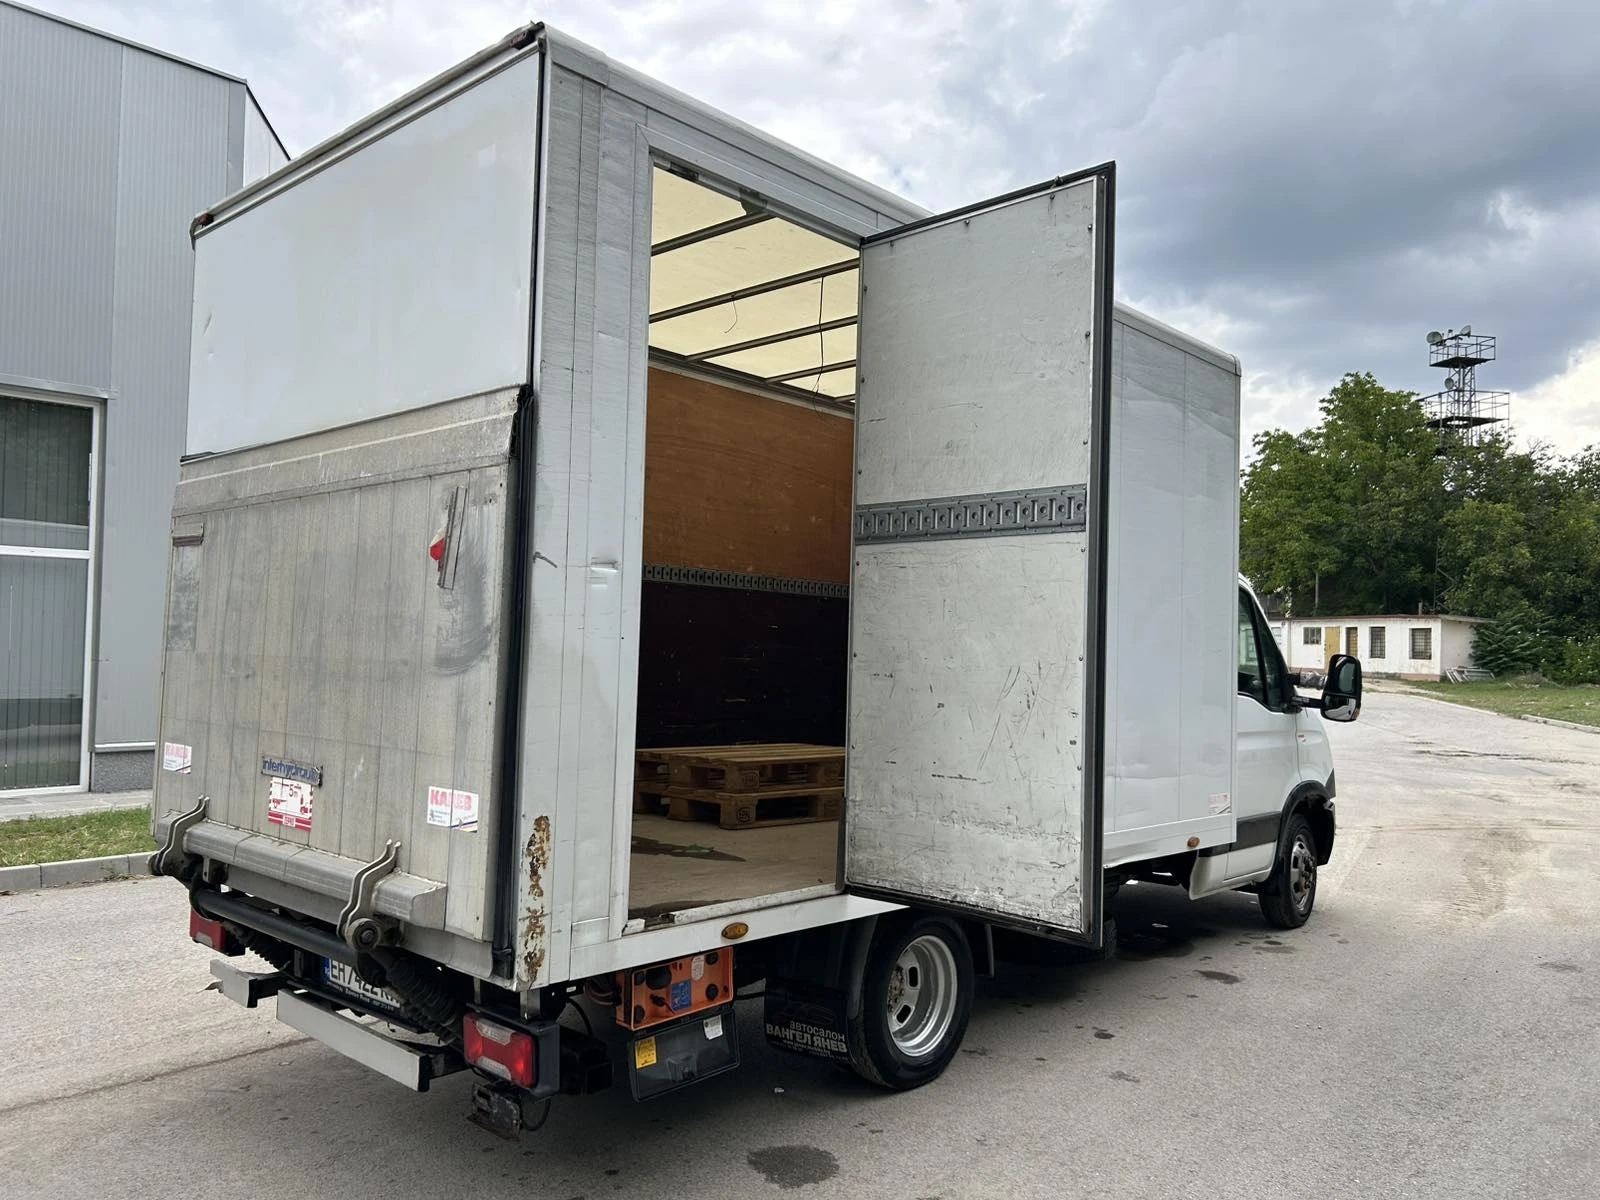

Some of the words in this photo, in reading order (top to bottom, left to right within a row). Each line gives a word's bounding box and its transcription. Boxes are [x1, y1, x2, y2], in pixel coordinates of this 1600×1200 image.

[766, 1023, 812, 1045] ВАНГЕЛ
[813, 1035, 848, 1053] ЯНЕВ
[789, 1020, 845, 1042] автосалон
